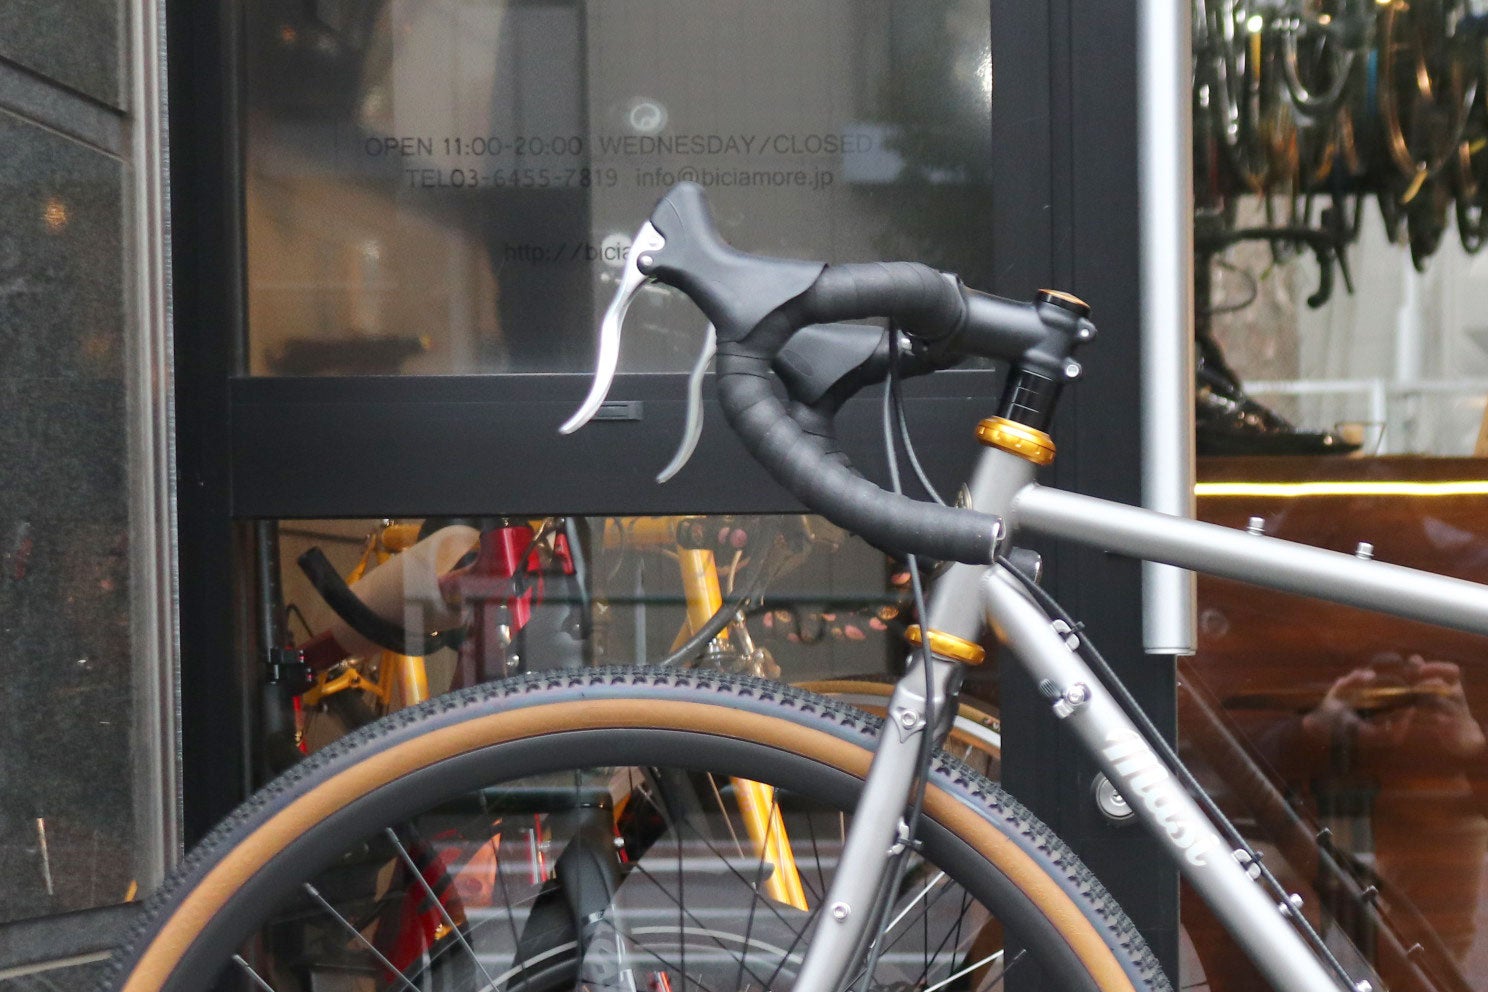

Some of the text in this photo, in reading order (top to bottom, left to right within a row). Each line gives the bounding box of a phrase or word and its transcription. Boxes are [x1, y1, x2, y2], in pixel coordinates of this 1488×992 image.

[364, 134, 873, 157] OPEN 11:00-20:00 WEDNESDAY/CLOSED
[636, 166, 834, 190] info@biciamore.jp
